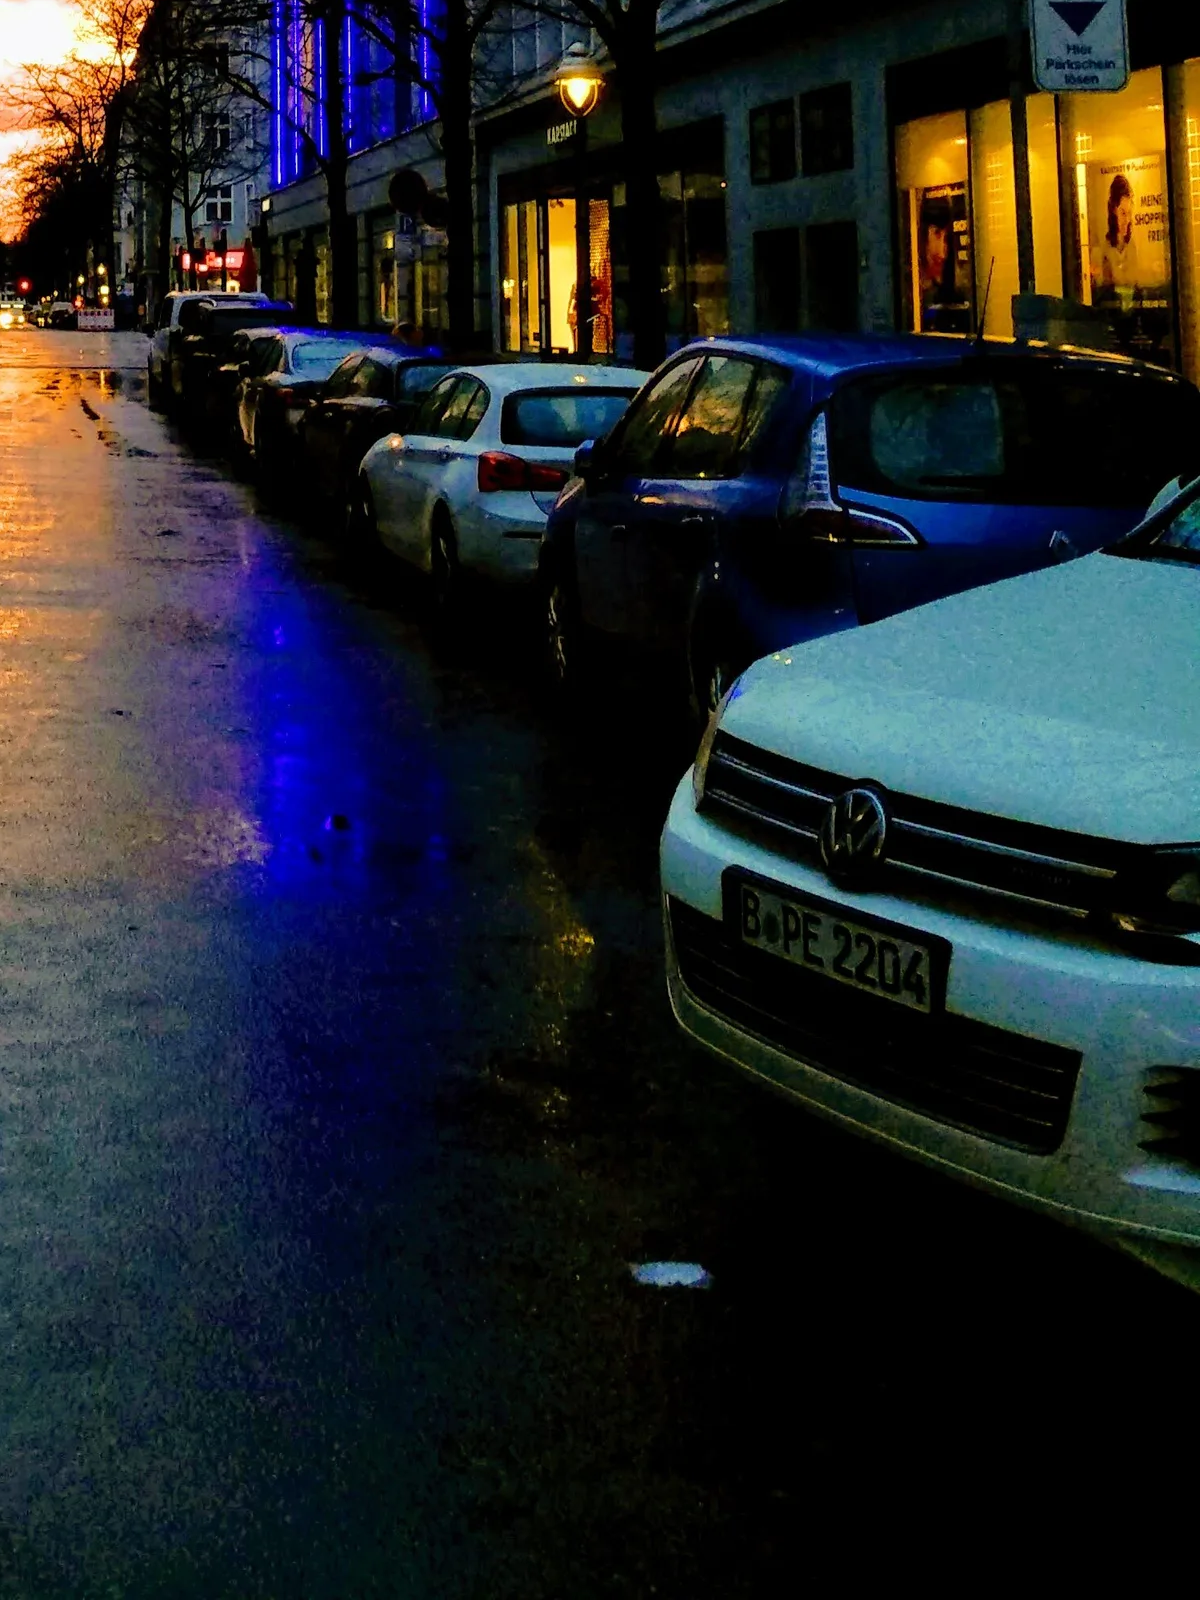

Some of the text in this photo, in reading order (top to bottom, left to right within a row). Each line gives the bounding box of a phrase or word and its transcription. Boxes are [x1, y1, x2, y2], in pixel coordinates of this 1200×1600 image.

[1066, 43, 1092, 55] Hier
[1046, 58, 1116, 70] Parkschein
[1064, 73, 1099, 84] lösen
[741, 890, 928, 1005] B PE 2204
